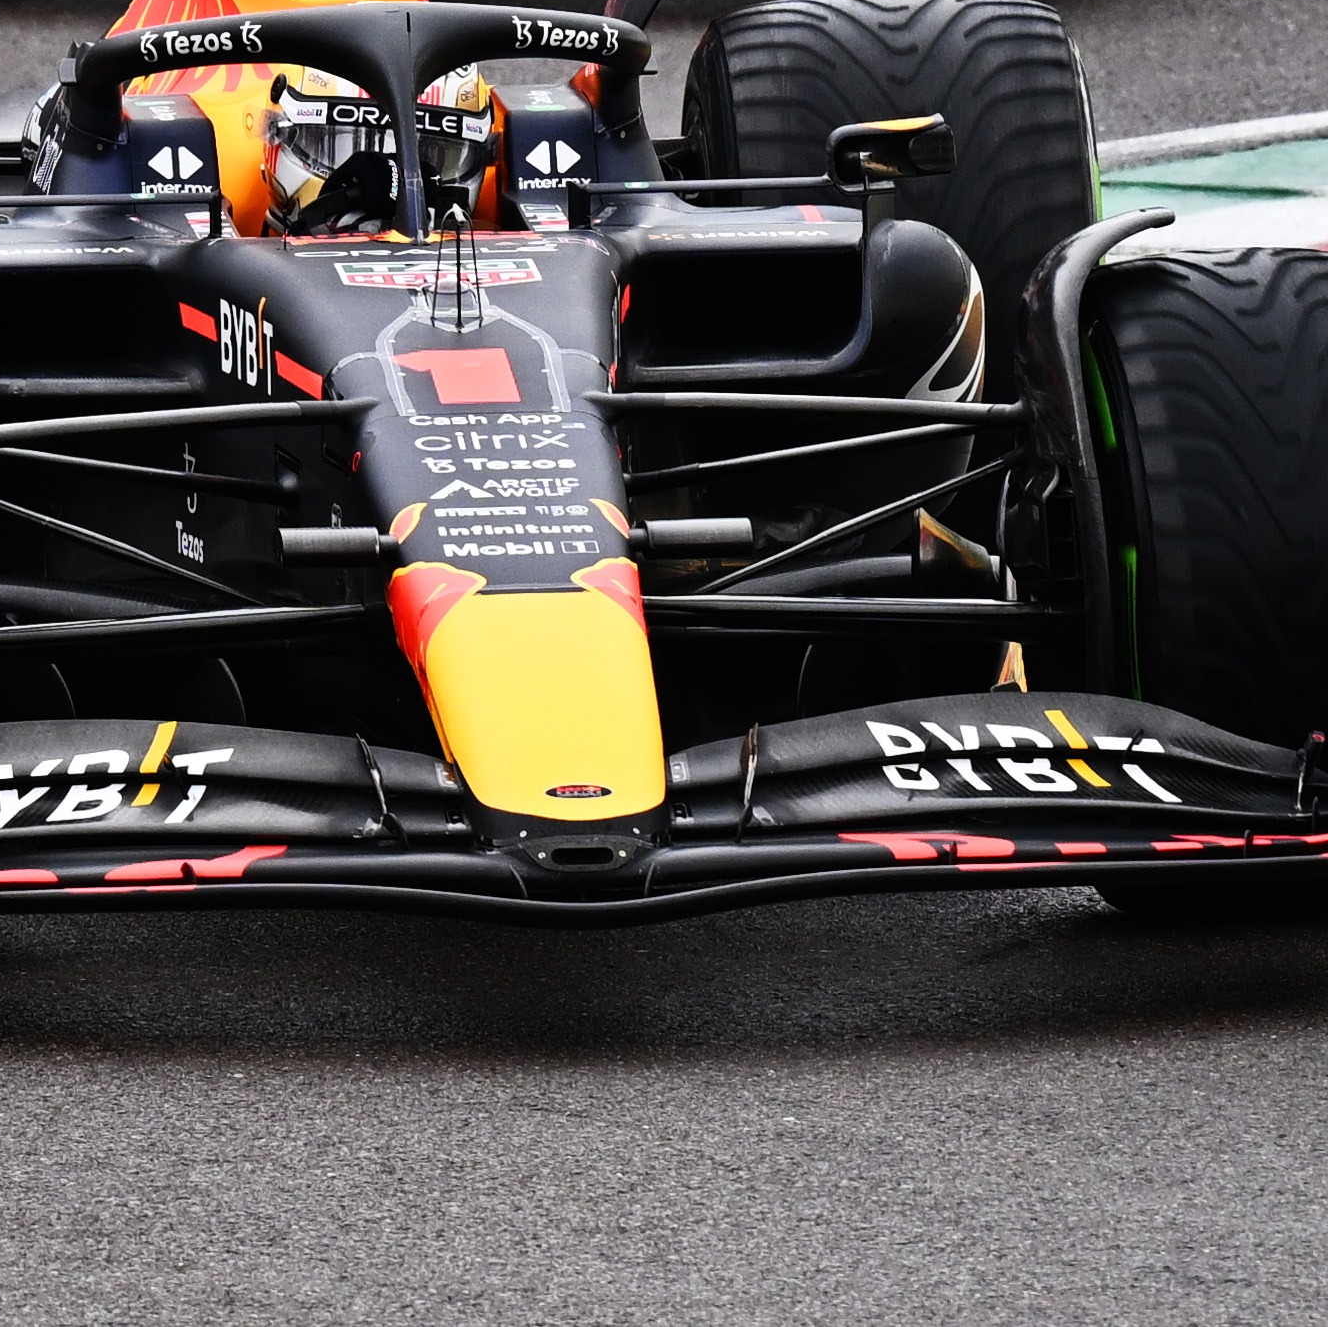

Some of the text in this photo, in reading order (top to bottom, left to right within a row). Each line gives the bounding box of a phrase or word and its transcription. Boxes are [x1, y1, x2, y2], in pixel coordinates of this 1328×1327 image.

[163, 30, 234, 56] Tezos
[537, 20, 600, 50] Tezos
[140, 181, 213, 194] inter.mx
[220, 296, 274, 396] BYBIT
[388, 347, 522, 405] 1
[408, 414, 563, 426] Cash App
[414, 429, 570, 452] citrix
[463, 458, 577, 471] Tezos
[482, 478, 580, 489] ARCTIC
[497, 487, 572, 498] WOLF
[175, 520, 205, 565] Tezos
[443, 541, 555, 557] Mobil
[865, 709, 1183, 803] BYBIT
